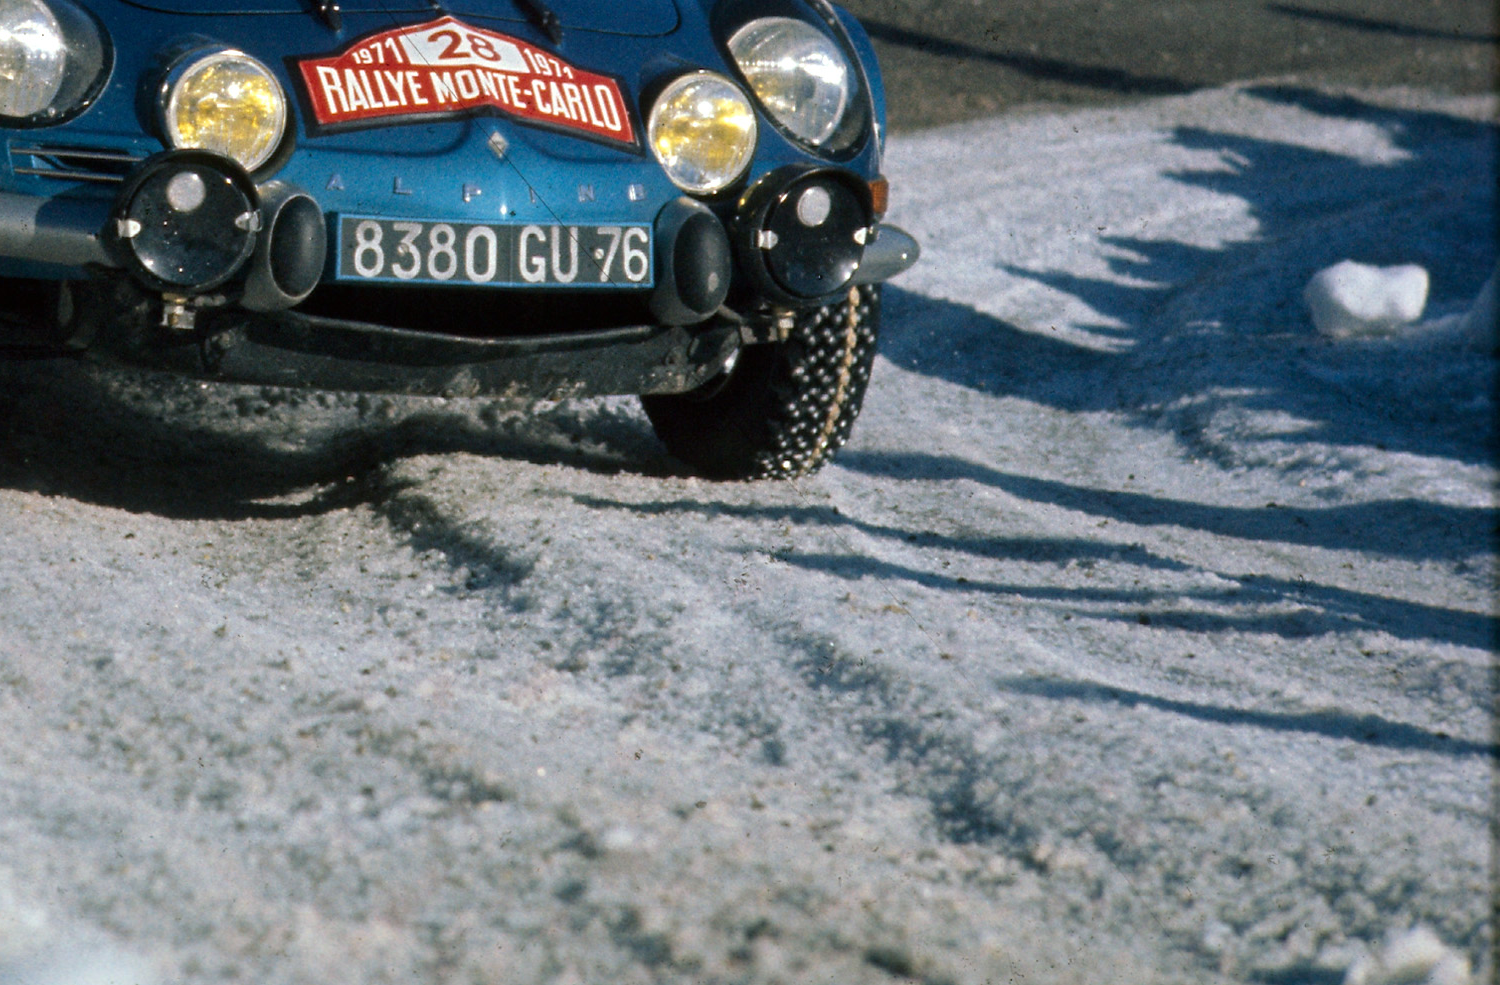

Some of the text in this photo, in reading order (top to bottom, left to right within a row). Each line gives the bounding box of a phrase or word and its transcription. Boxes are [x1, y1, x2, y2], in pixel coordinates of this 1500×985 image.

[352, 37, 403, 65] 1971
[427, 30, 502, 62] 28
[316, 66, 622, 133] RALLYE MONTE-CARLO
[354, 220, 649, 283] 8380 GU 76
